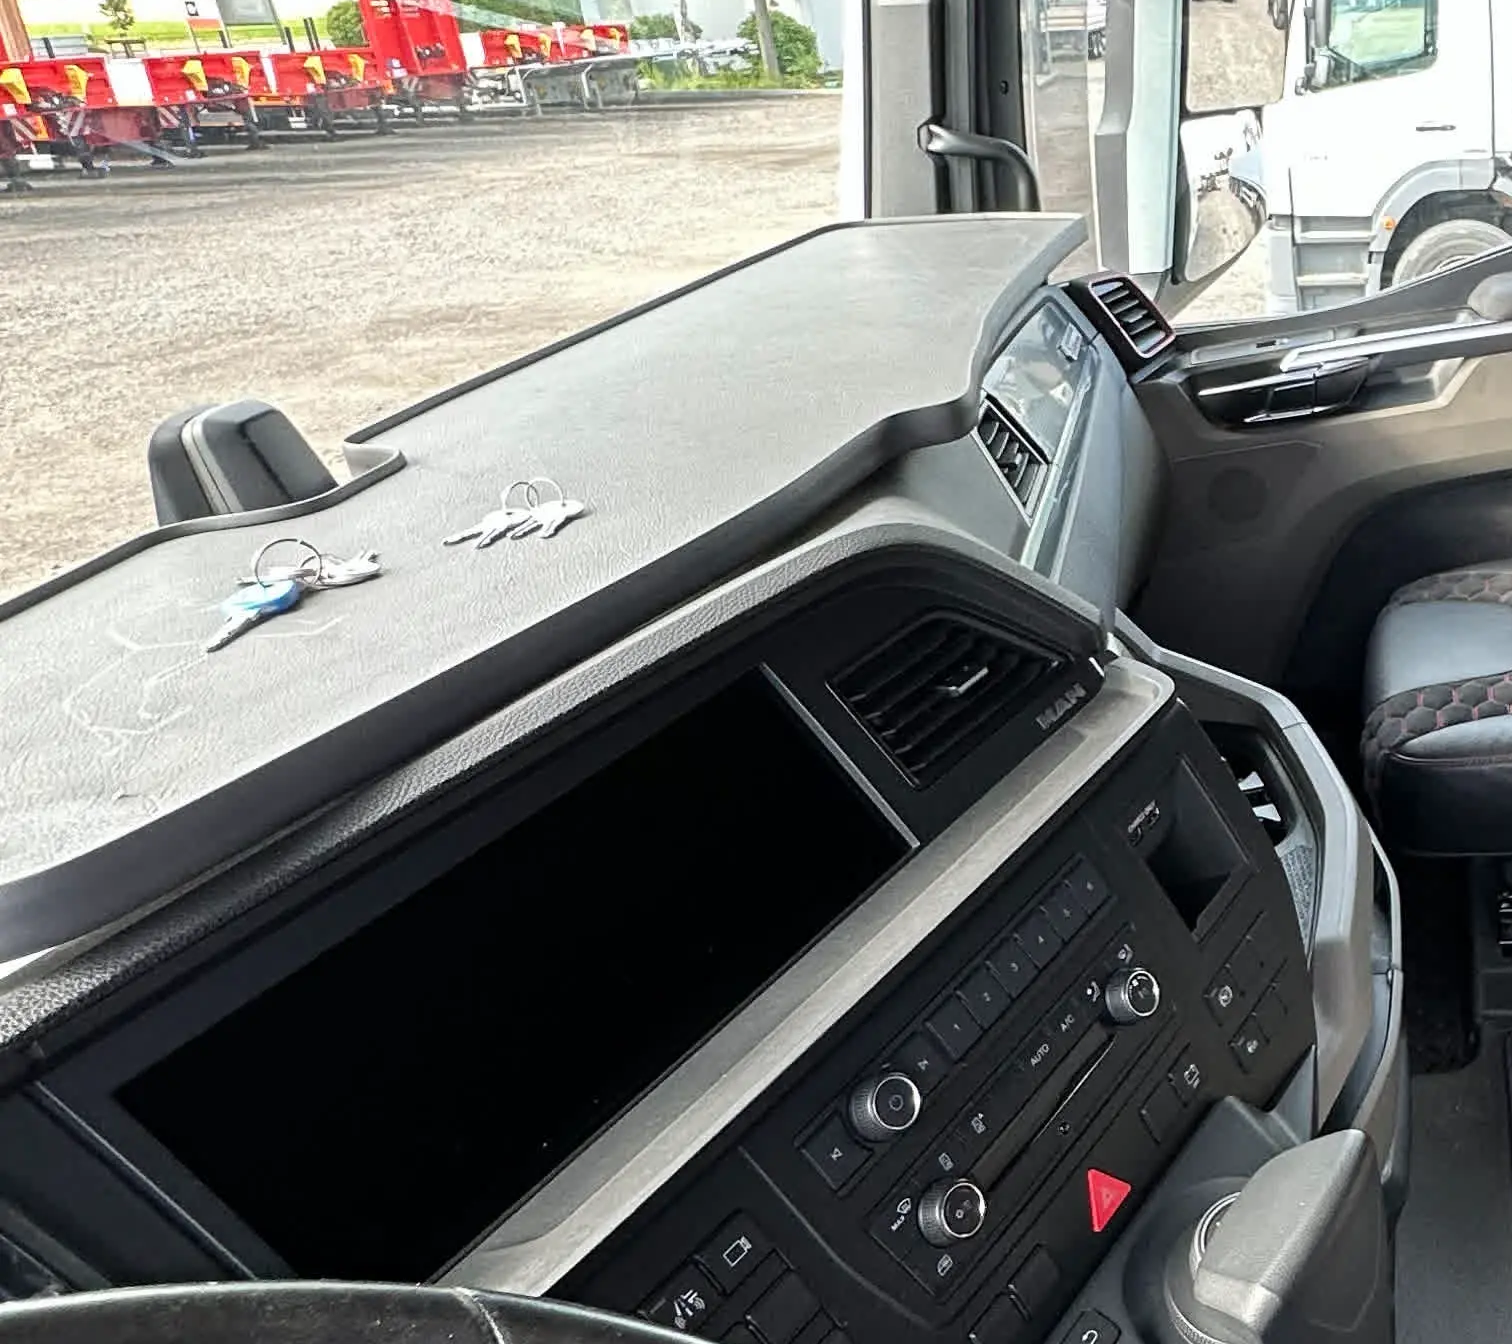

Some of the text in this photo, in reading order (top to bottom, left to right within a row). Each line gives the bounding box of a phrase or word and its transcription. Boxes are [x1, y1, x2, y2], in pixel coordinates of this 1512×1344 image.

[1036, 683, 1086, 729] MAN
[1060, 1014, 1075, 1032] A/C
[1029, 1043, 1050, 1067] AUTO
